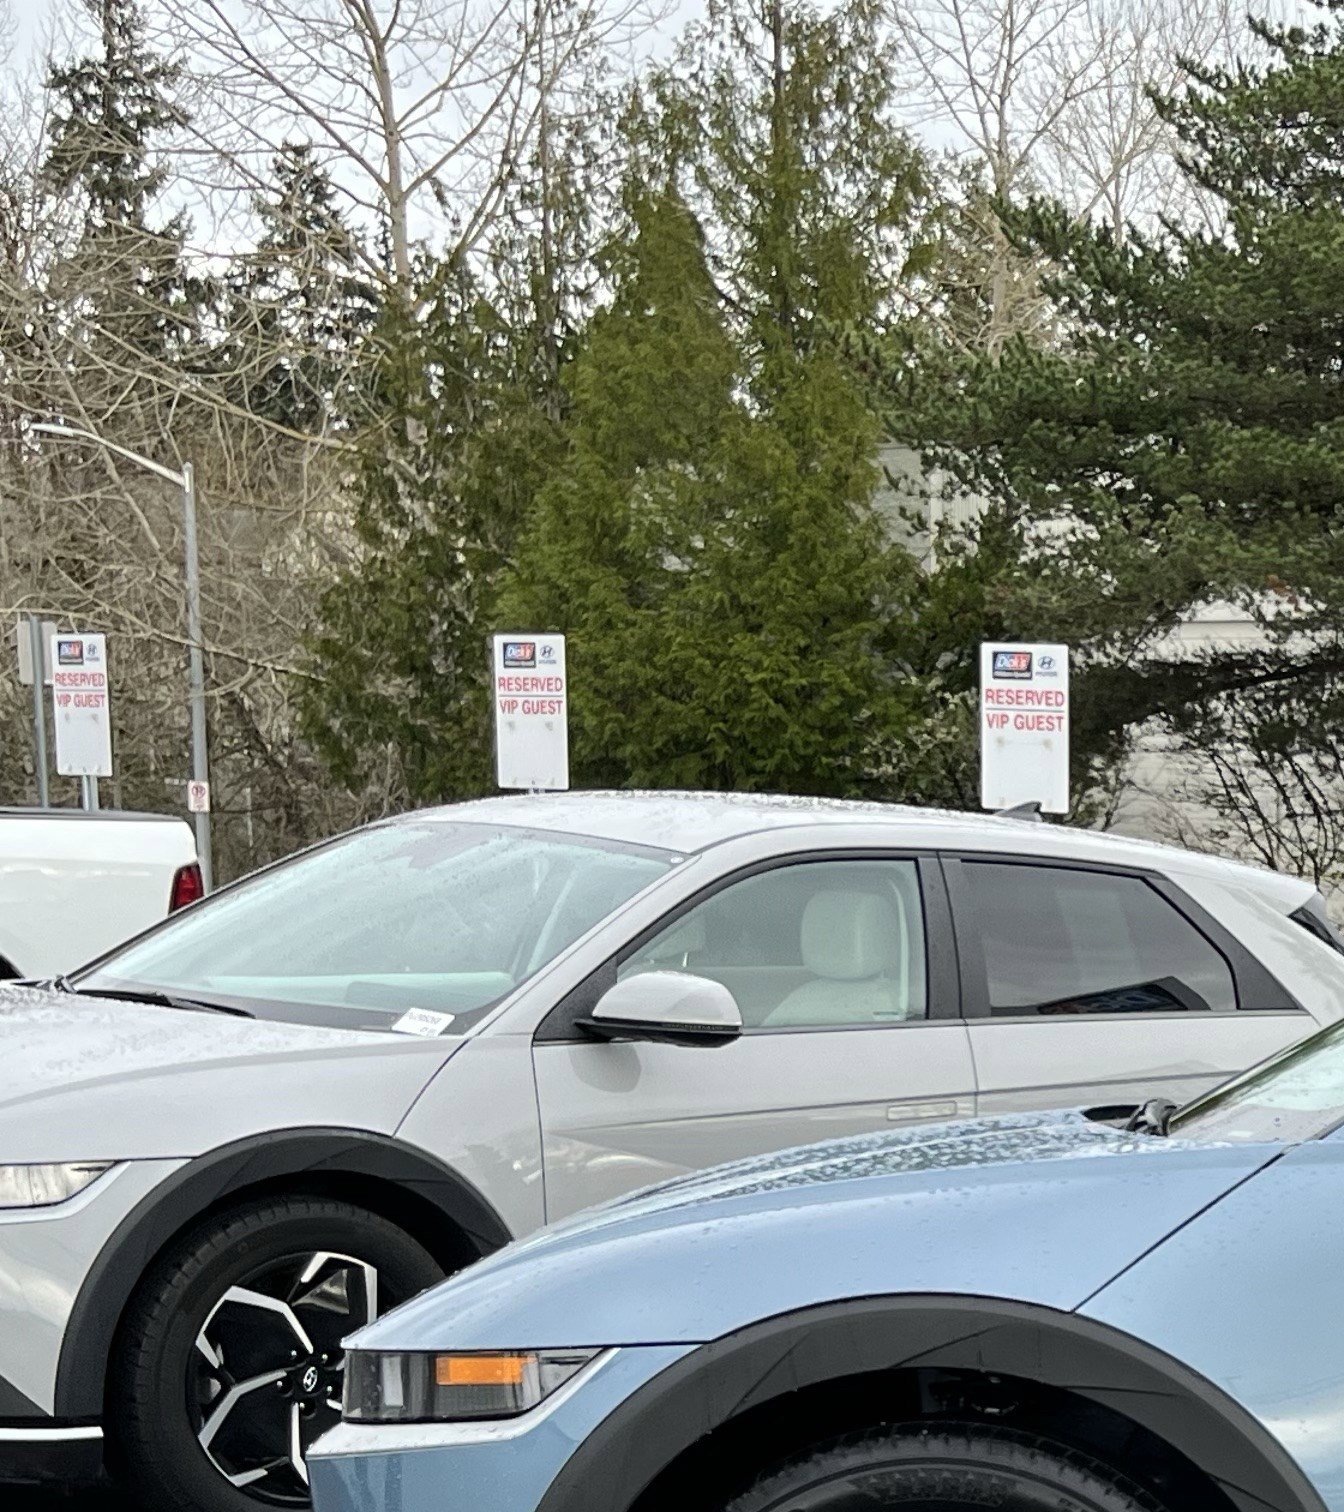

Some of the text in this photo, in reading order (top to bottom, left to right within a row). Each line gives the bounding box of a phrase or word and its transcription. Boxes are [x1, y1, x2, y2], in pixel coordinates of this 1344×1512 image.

[55, 672, 105, 687] RESERVED
[498, 676, 563, 692] RESERVED
[56, 694, 105, 708] VIP GUEST
[985, 689, 1065, 707] RESERVED
[499, 700, 563, 715] VIP GUEST
[986, 713, 1065, 732] VIP GUEST
